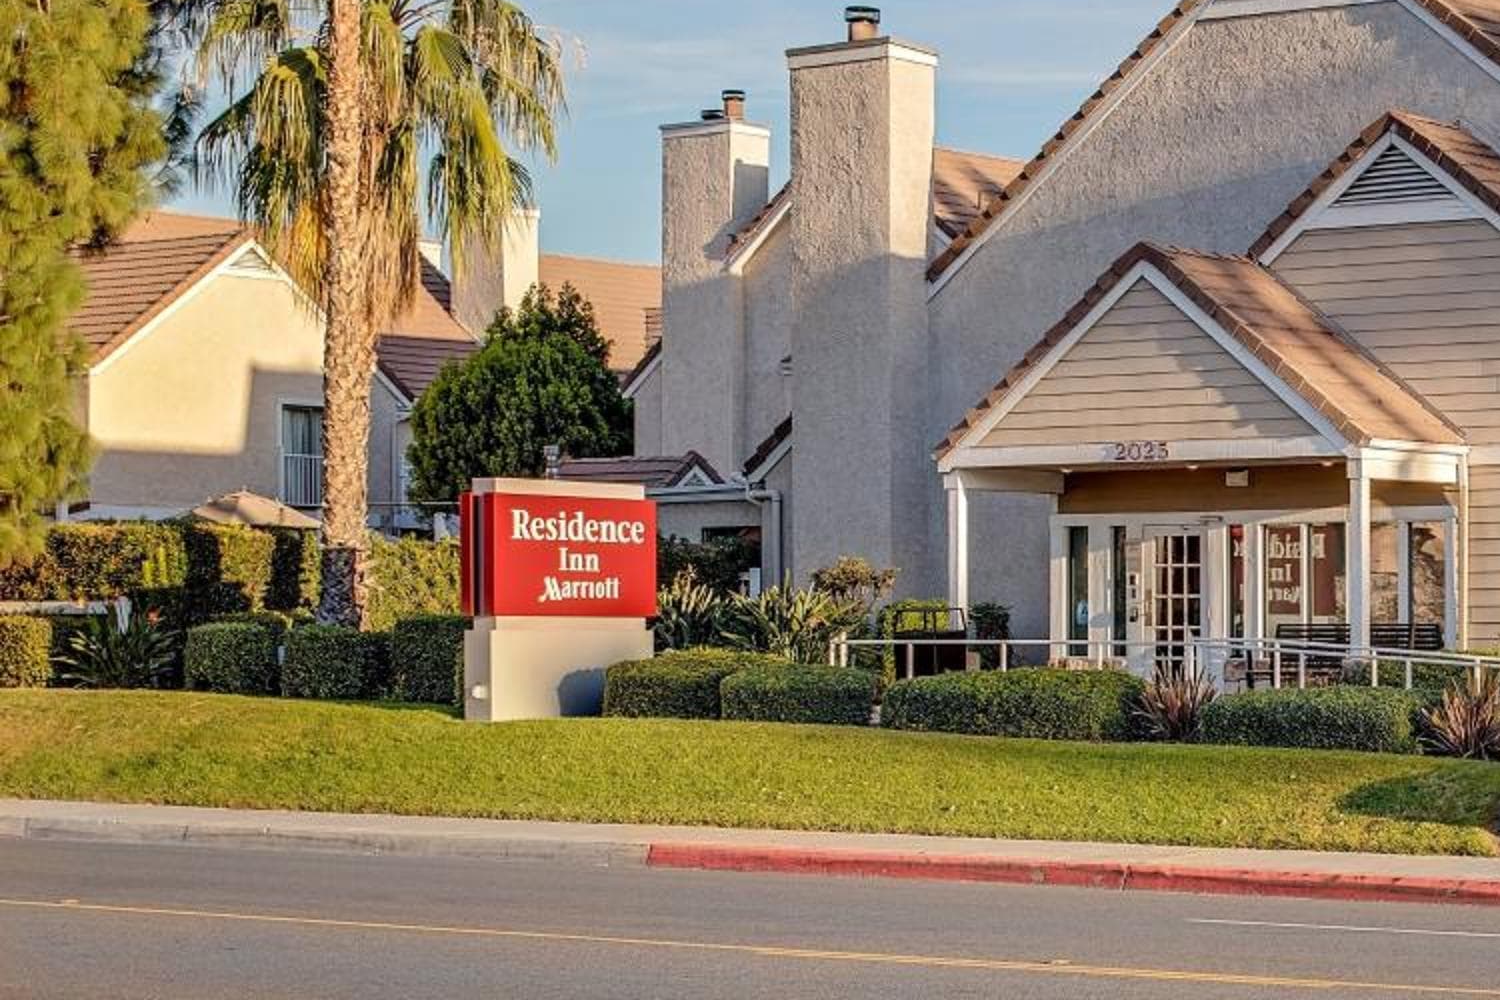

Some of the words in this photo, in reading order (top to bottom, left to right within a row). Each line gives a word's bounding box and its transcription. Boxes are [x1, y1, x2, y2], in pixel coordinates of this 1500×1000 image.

[1115, 441, 1169, 460] 2025
[511, 509, 645, 543] Residence
[559, 547, 600, 572] Inn
[539, 577, 620, 602] Marriott
